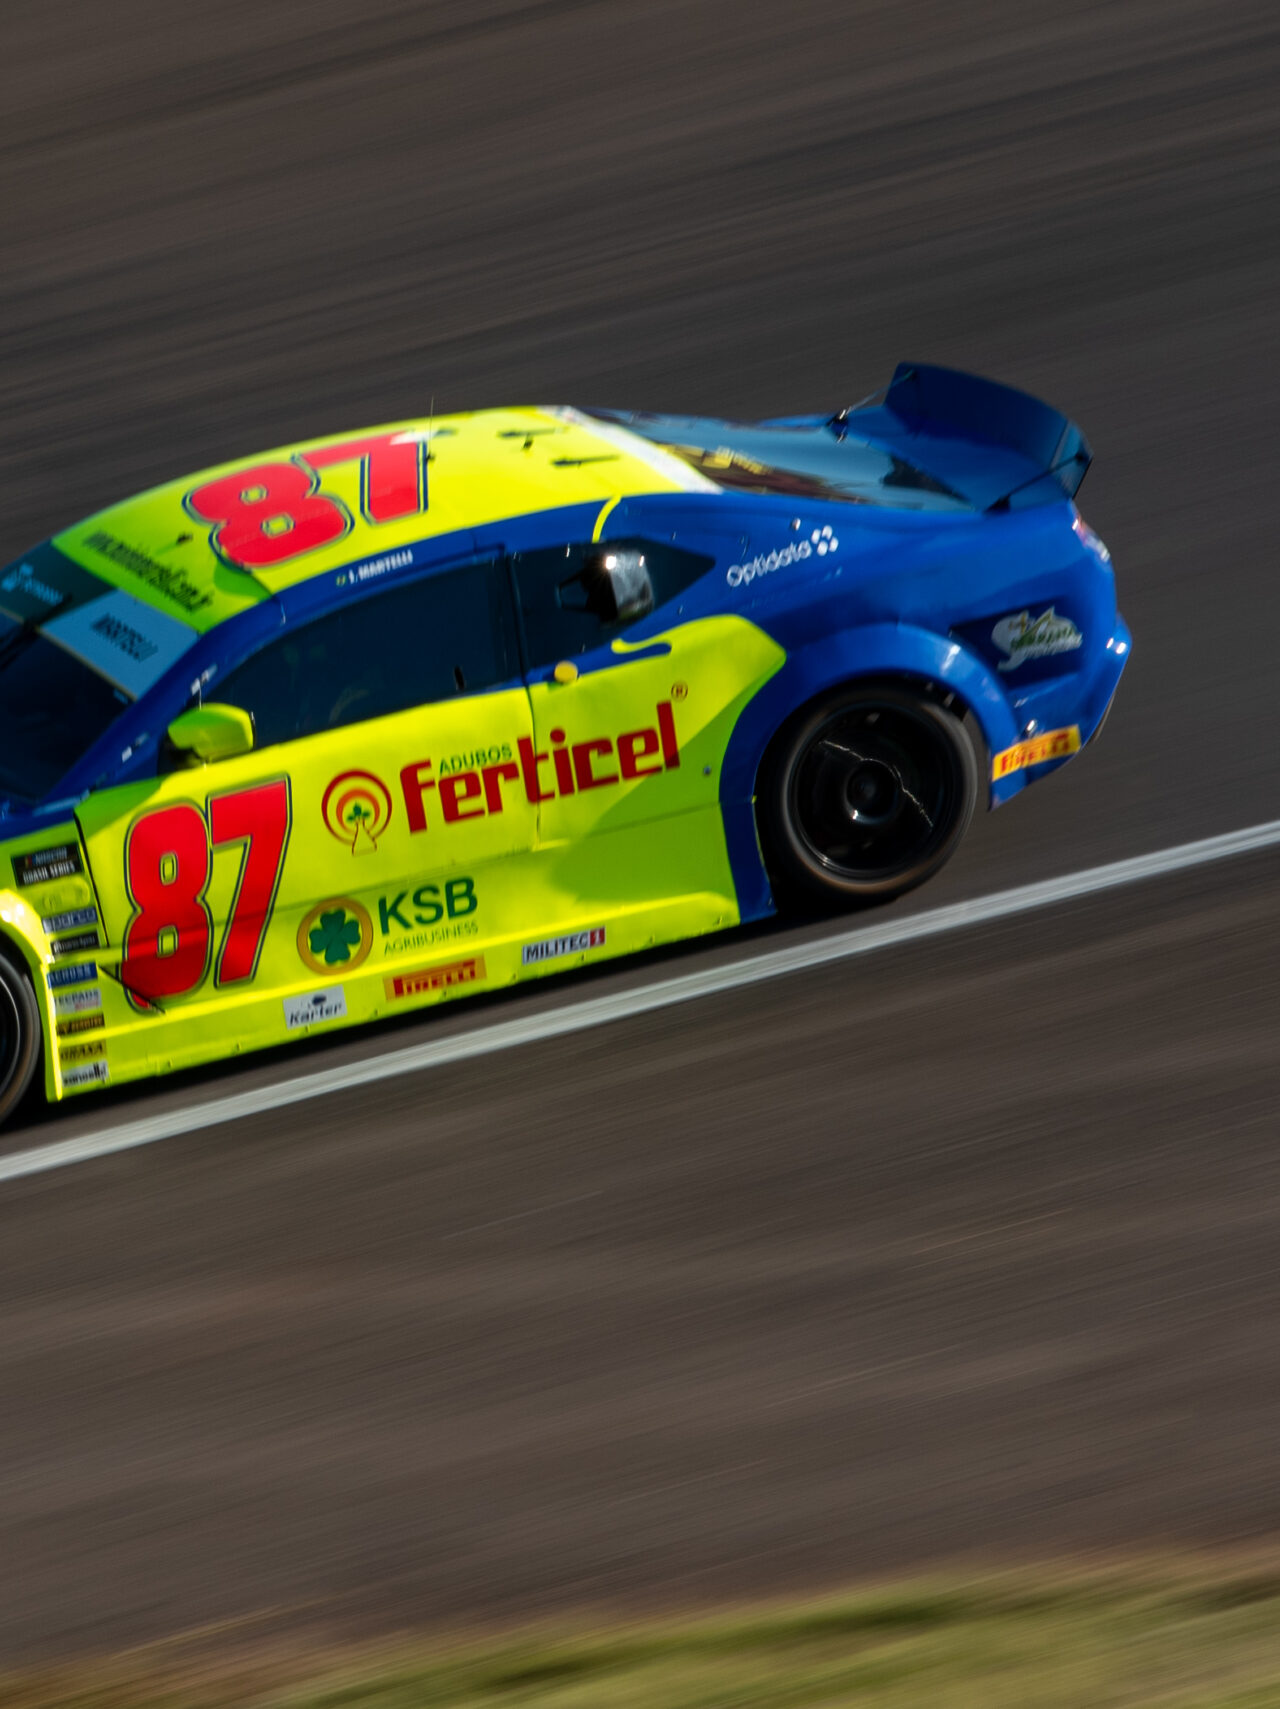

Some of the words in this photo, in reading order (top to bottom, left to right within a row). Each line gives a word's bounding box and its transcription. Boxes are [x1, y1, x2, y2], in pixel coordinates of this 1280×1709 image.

[183, 428, 428, 574] 87
[439, 743, 513, 776] ADUBOS
[120, 773, 294, 1015] 87
[378, 876, 479, 937] KSB
[384, 921, 479, 956] AGRIBUSINESS
[392, 960, 476, 998] PIRELLI
